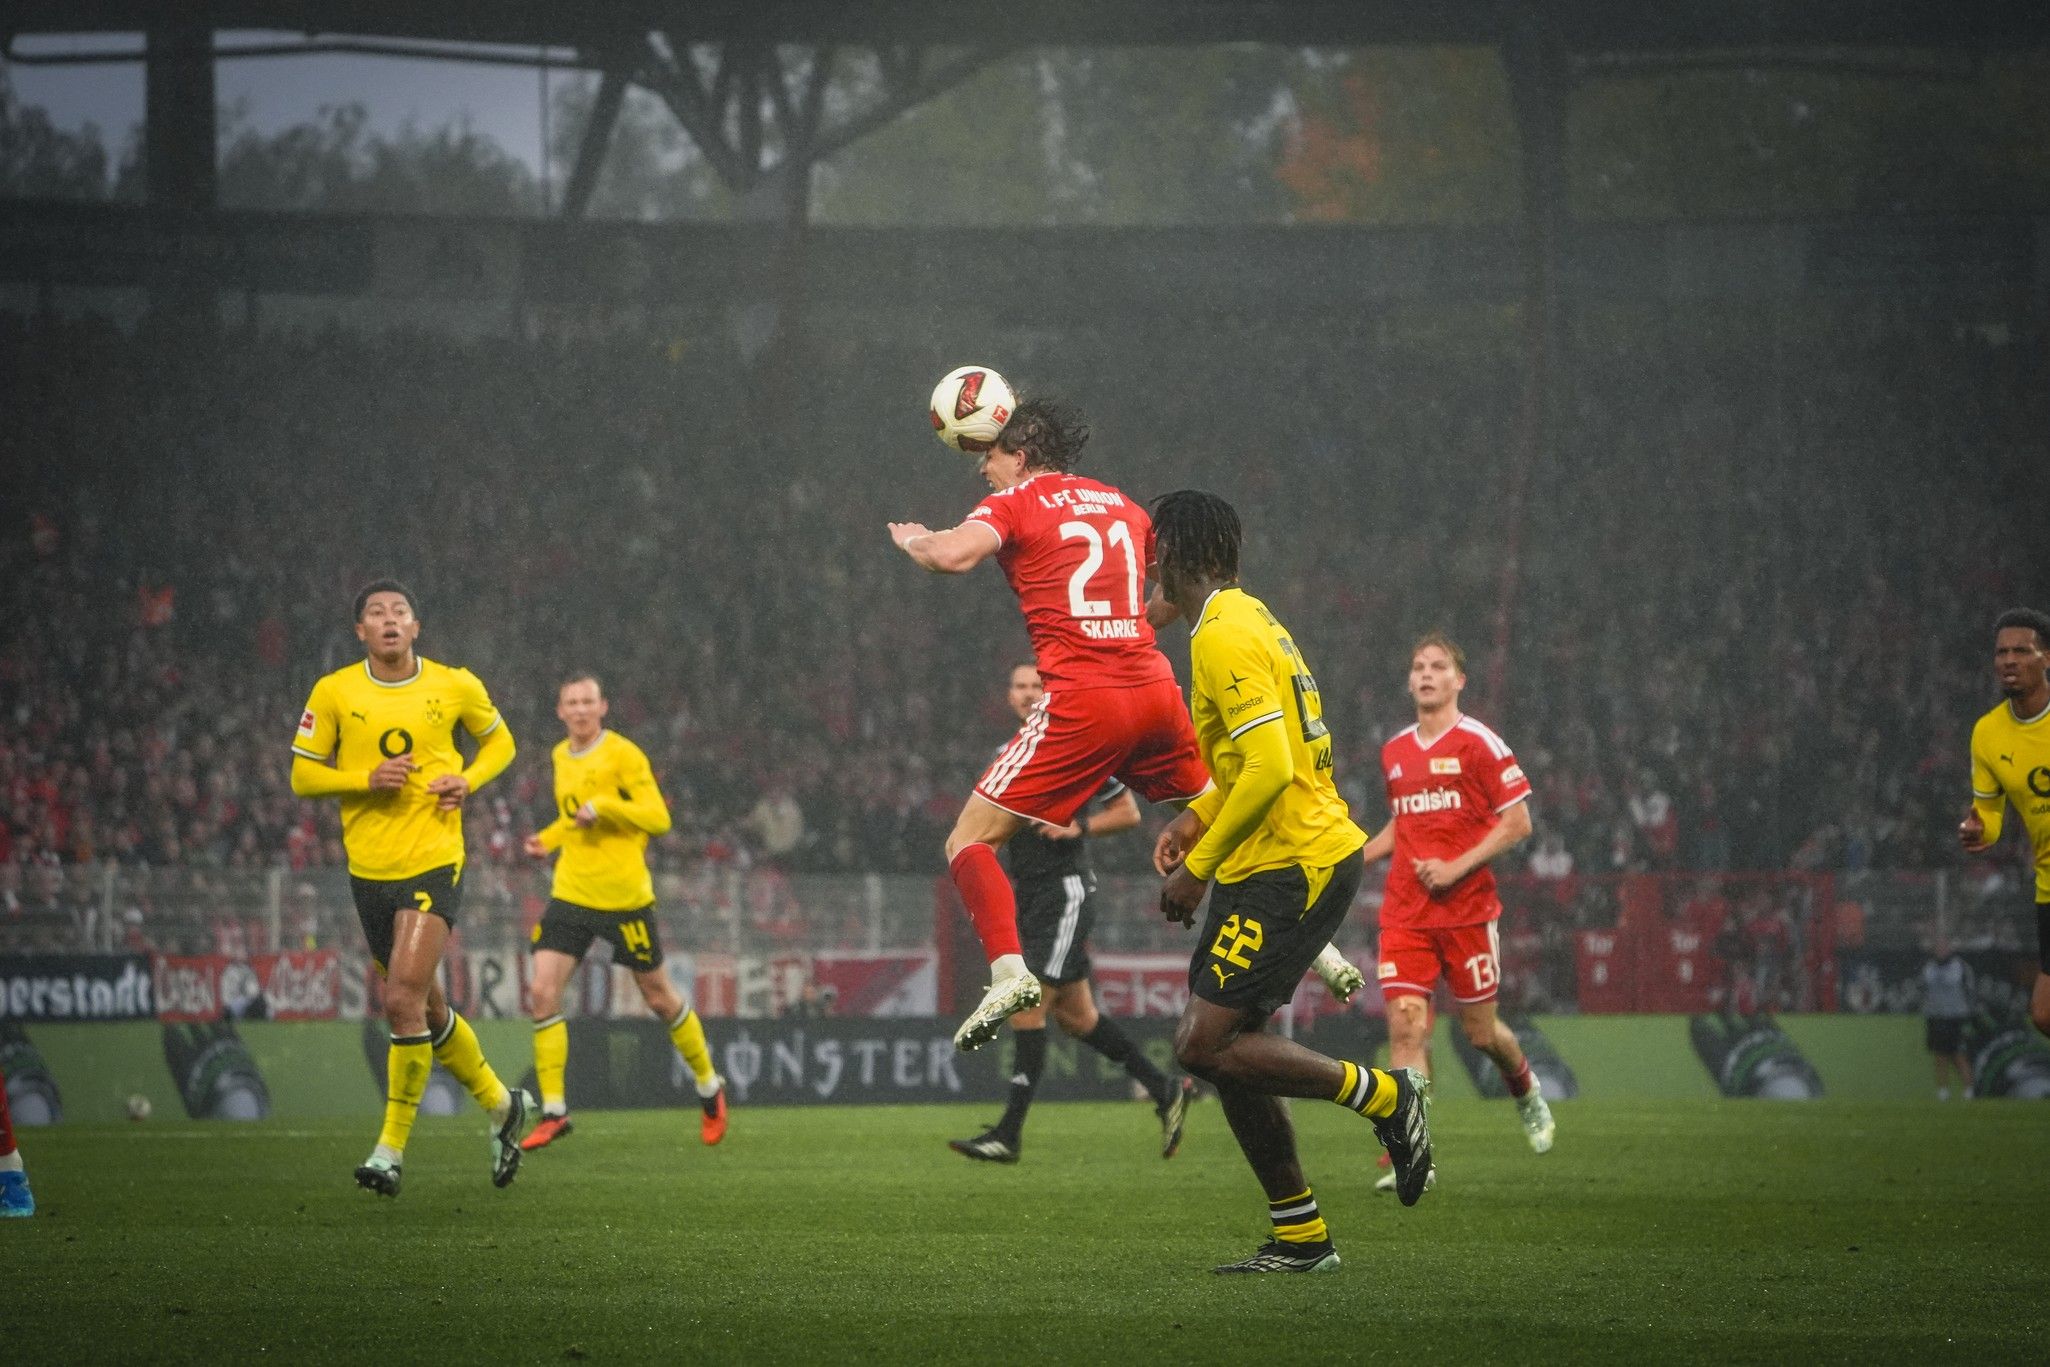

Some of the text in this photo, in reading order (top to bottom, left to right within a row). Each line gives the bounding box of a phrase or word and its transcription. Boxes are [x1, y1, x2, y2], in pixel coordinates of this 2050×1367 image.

[1052, 489, 1077, 508] FC
[1075, 488, 1125, 508] UNION
[1072, 503, 1108, 516] BERLIN
[1058, 519, 1140, 617] 21
[1080, 618, 1140, 639] SKARKE
[1227, 694, 1265, 718] Polestar
[1402, 786, 1461, 814] raisin
[619, 920, 651, 953] 14
[1210, 914, 1263, 970] 22
[1464, 952, 1496, 991] 13
